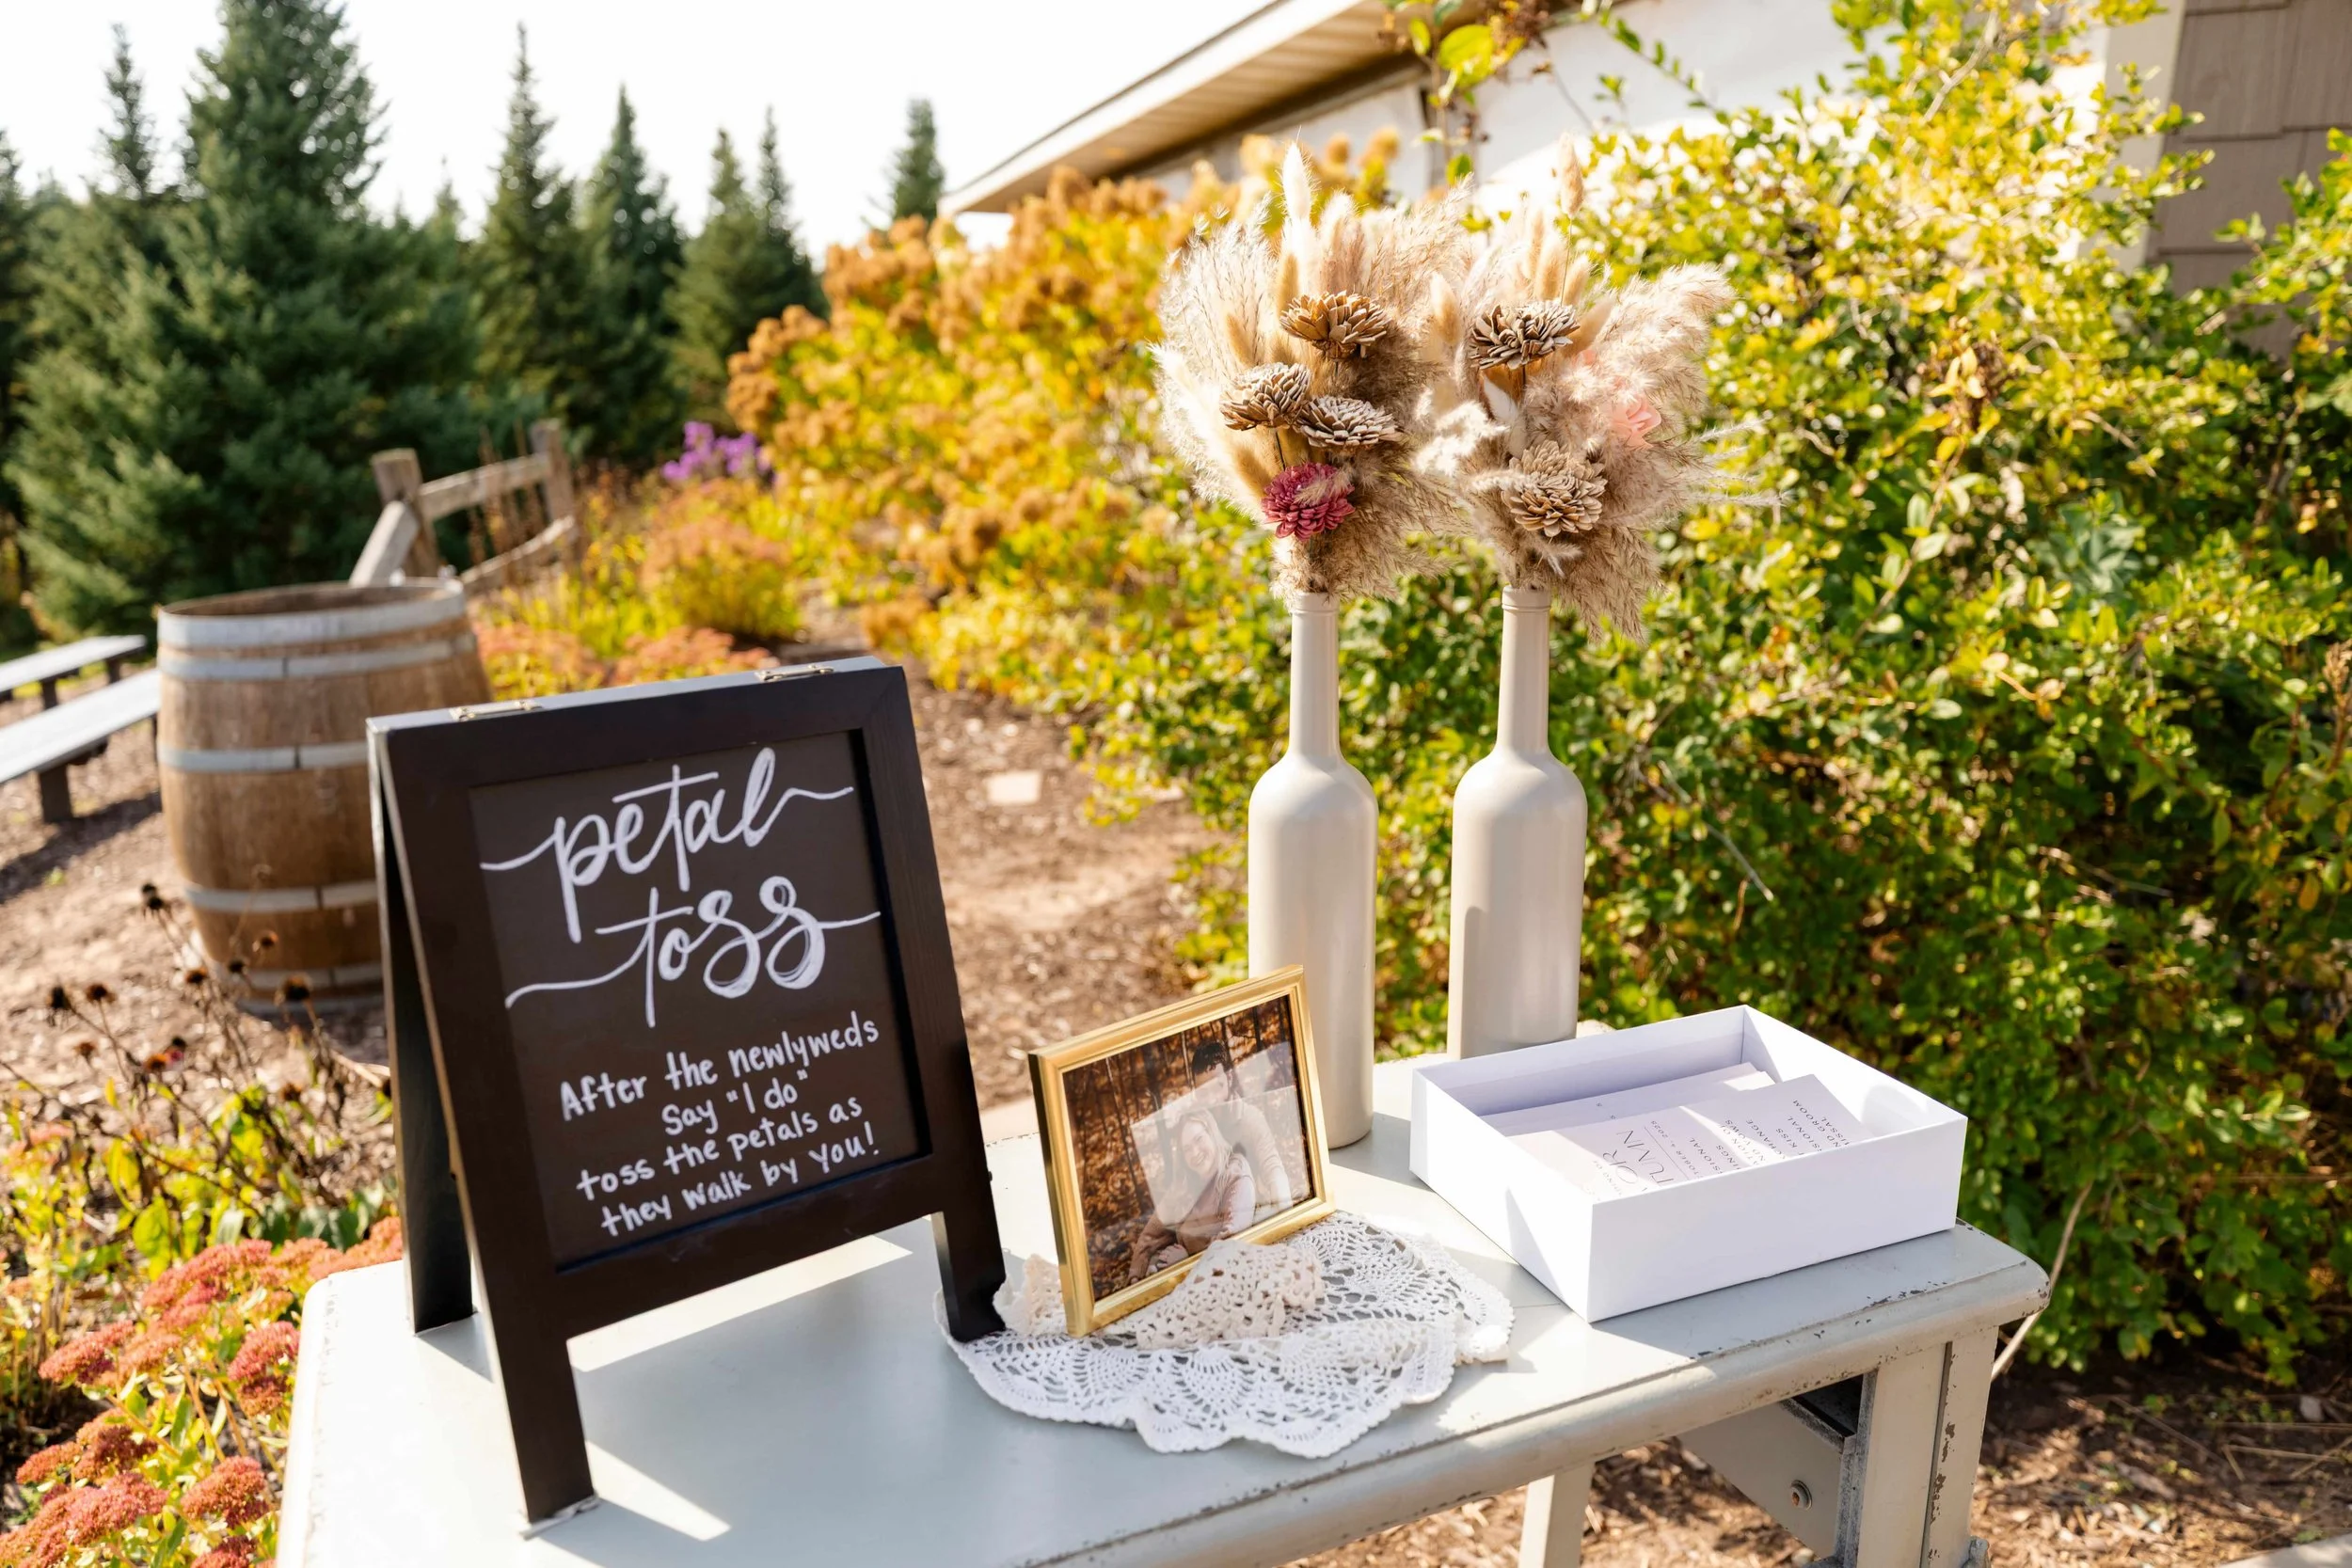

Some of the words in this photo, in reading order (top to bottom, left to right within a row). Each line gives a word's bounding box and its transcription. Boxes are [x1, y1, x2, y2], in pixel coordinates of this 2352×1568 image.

[481, 748, 853, 942] petal
[506, 876, 881, 1027] toss
[562, 1073, 646, 1120] After
[665, 1053, 718, 1090] the
[728, 1011, 879, 1077] newlyweds
[1793, 1100, 1825, 1132] GROOM
[577, 1160, 655, 1200] toss
[664, 1140, 719, 1174] the
[727, 1111, 818, 1161] petals
[830, 1098, 862, 1123] as
[1776, 1129, 1798, 1148] KISS
[602, 1196, 672, 1235] they
[760, 1159, 798, 1186] by
